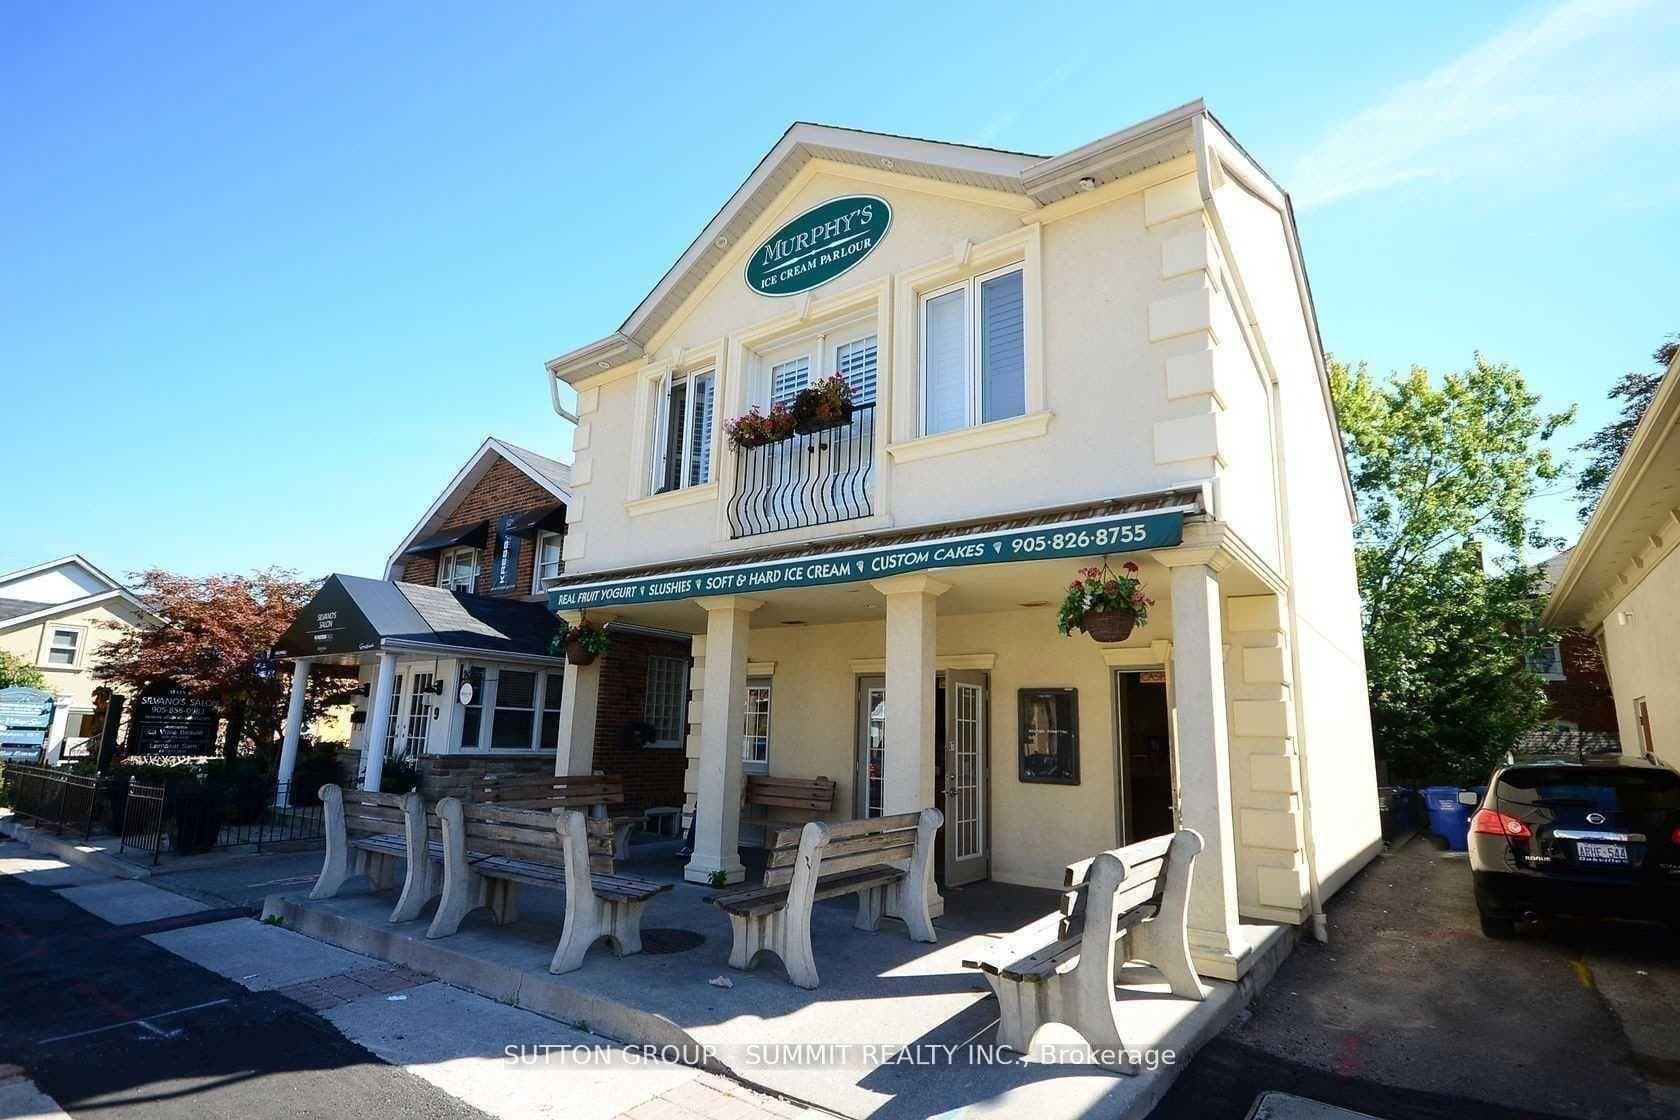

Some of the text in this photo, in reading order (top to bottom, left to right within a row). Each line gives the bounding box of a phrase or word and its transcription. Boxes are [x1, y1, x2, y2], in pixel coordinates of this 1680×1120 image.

[760, 238, 872, 289] ICE CREAM PARLOUR
[762, 204, 873, 265] MURPHY'S
[558, 593, 576, 605] REAL
[577, 591, 600, 603] FRUIT
[600, 585, 638, 601] YOGURT
[648, 580, 692, 596] SLUSHIES
[705, 575, 734, 590] SOFT
[736, 574, 747, 587] &
[749, 570, 781, 585] HARD
[784, 567, 804, 581] ICE
[806, 562, 851, 579] CREAM
[871, 551, 929, 572] CUSTOM
[933, 543, 985, 561] CAKES
